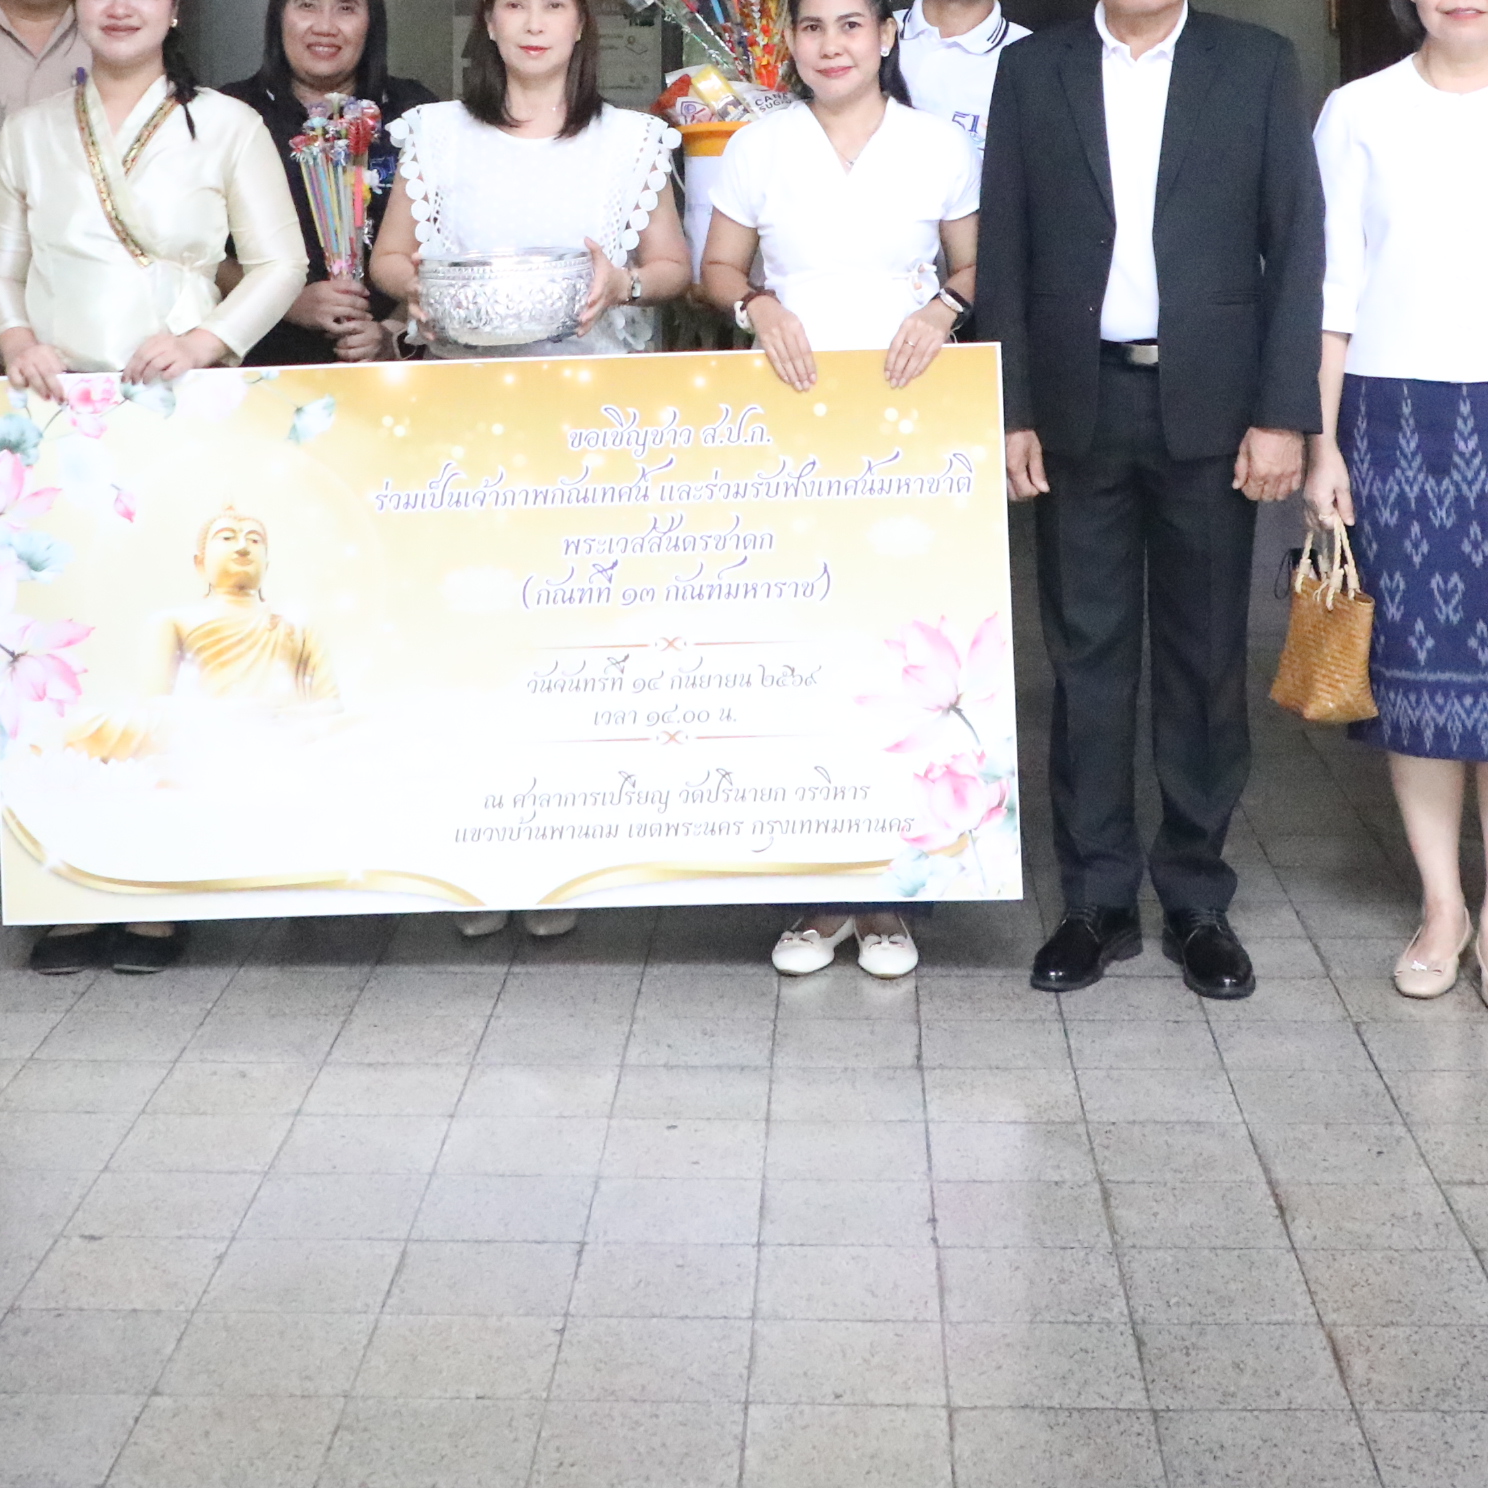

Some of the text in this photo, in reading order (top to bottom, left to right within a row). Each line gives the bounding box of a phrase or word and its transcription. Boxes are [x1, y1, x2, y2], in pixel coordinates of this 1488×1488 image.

[569, 406, 771, 457] ขอเชิญชาว ส.ป.ก.
[659, 450, 973, 502] และร่วมรับฟังเทศน์มหาชาติ
[563, 513, 774, 556] พระเวสสันดรชาดก
[632, 670, 664, 694] ๑๔
[670, 655, 752, 690] กันยายน
[593, 708, 638, 726] เวลา
[718, 707, 737, 723] น.
[483, 793, 504, 810] ณ
[512, 770, 671, 814] ศาลาการเปรียญ
[794, 765, 871, 801] วรวิหาร
[454, 809, 916, 853] แขวงบ้านพานถม เขตพระนคร กรุงเทพมหานคร
